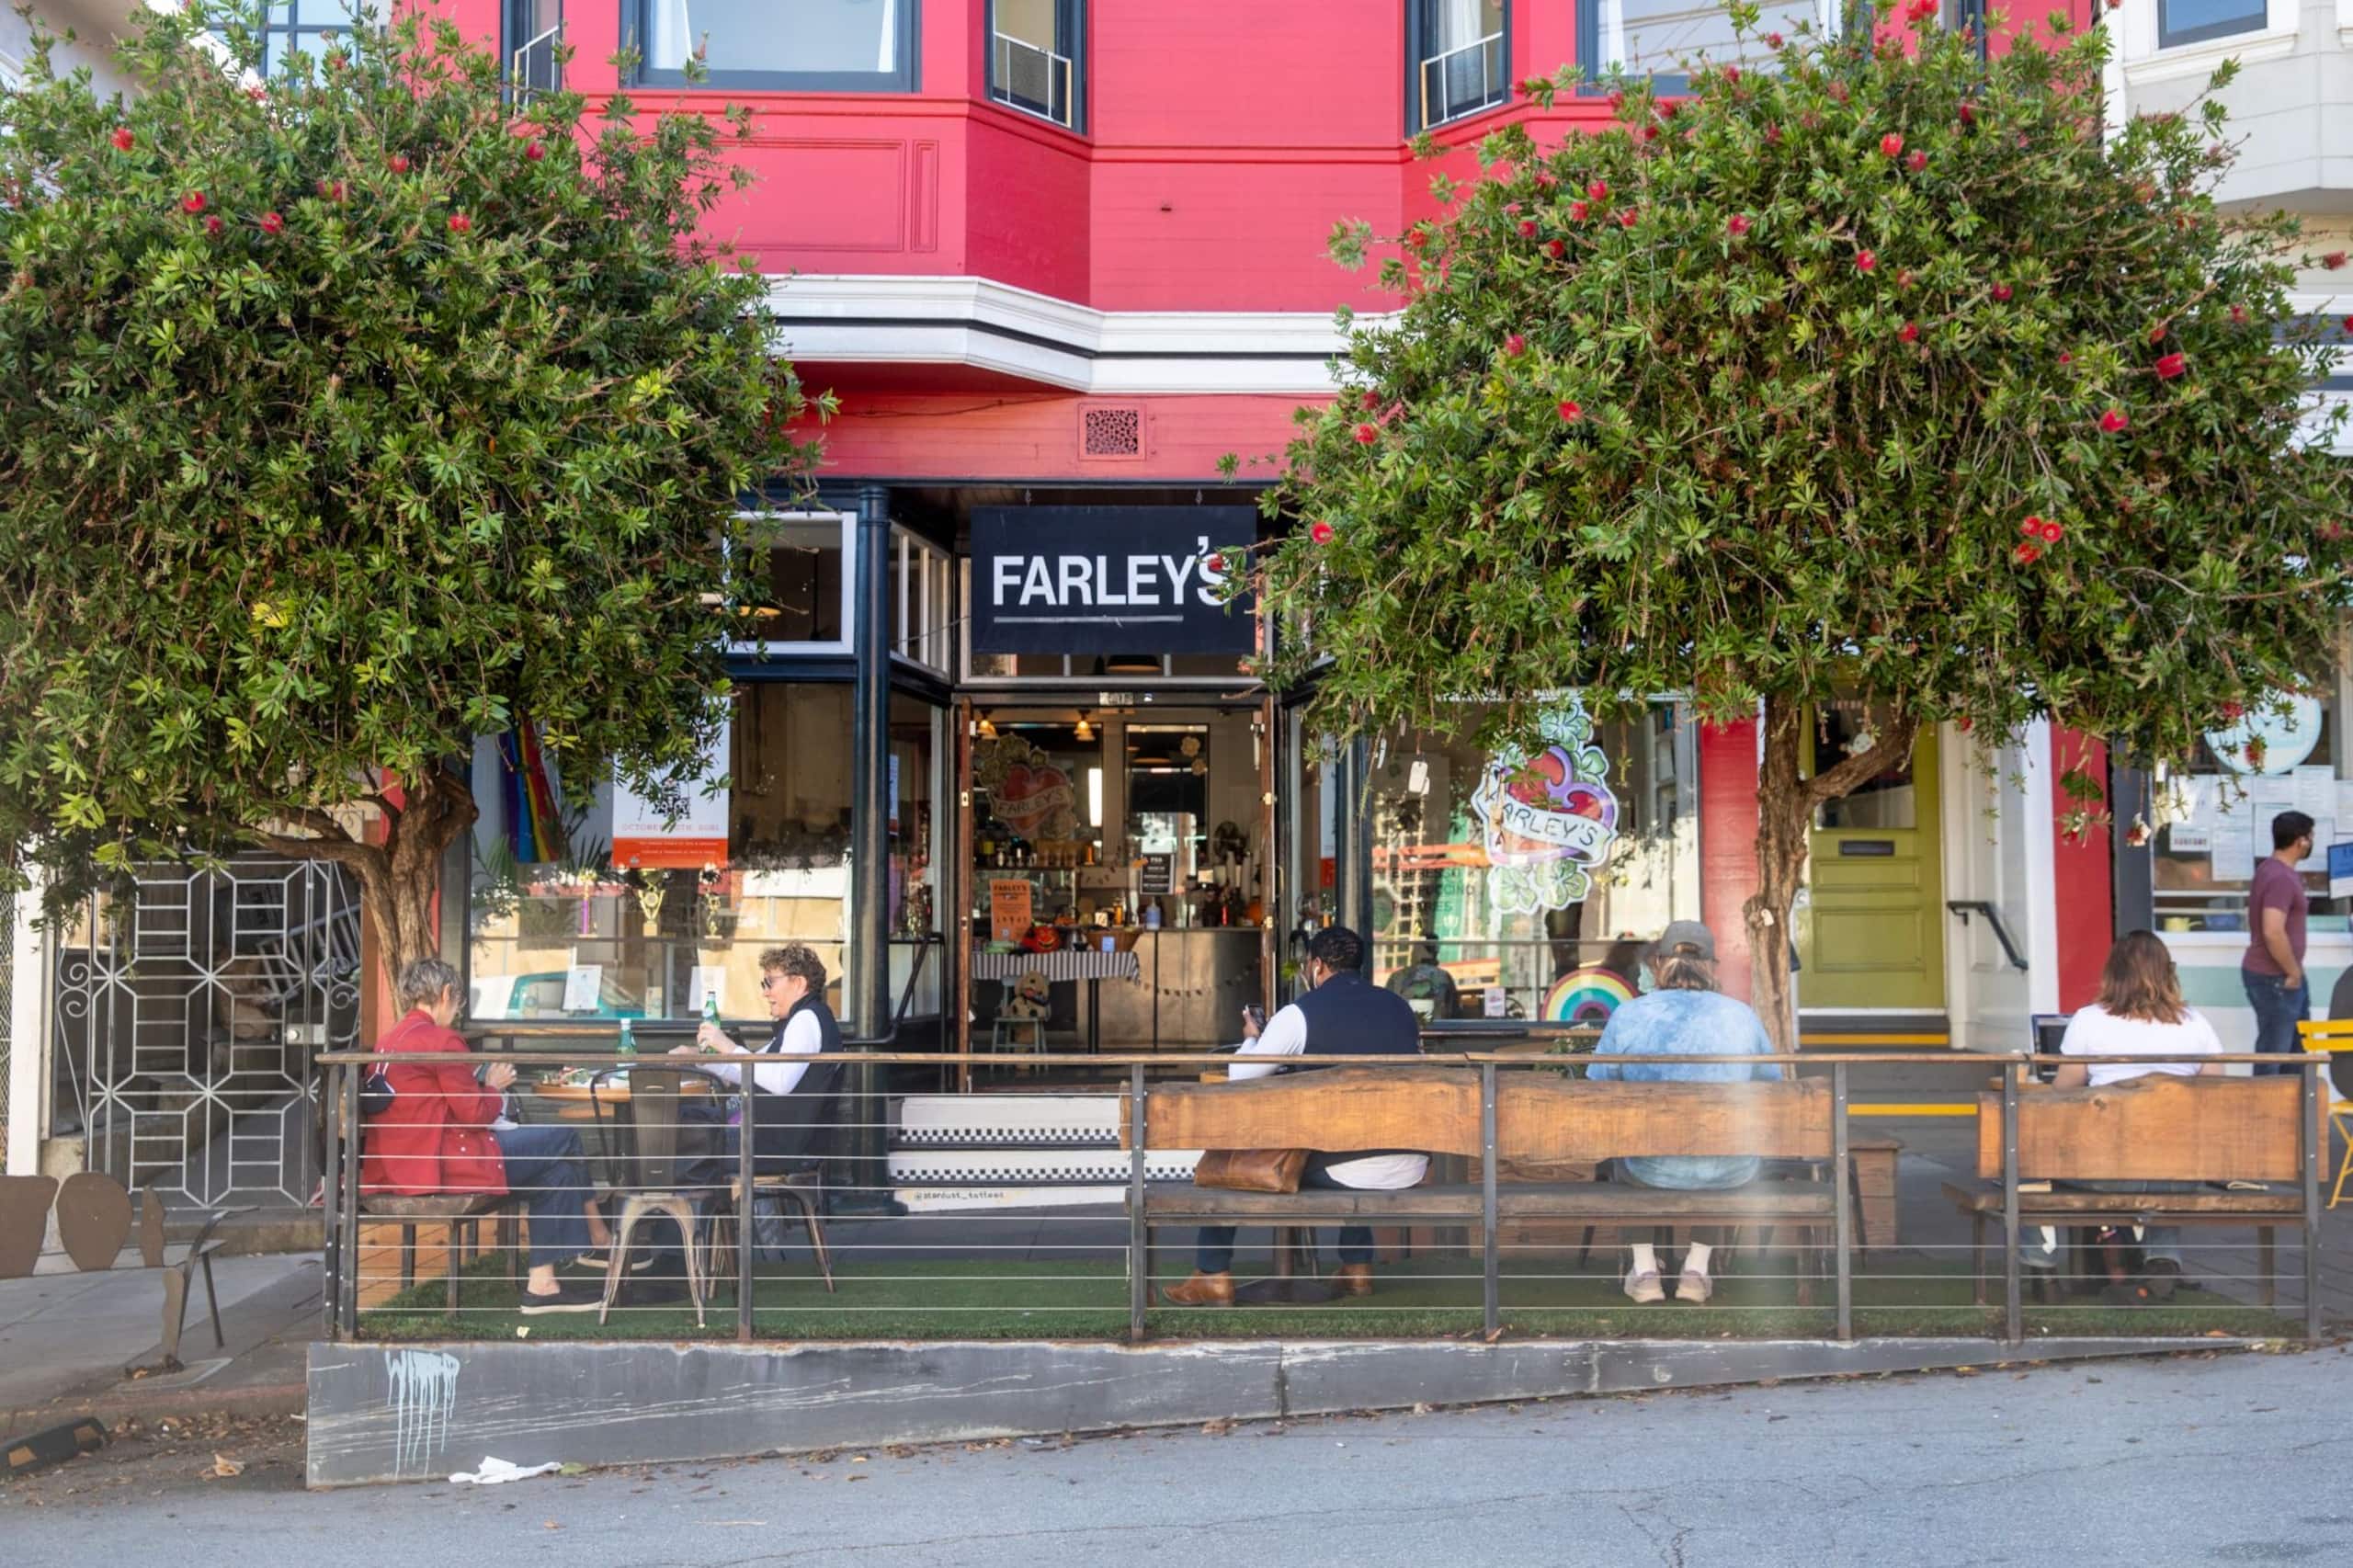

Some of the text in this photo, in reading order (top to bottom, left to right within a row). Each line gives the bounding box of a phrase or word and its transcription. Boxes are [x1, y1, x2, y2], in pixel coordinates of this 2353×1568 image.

[994, 536, 1232, 607] FARLEY'S
[998, 789, 1064, 813] FARLEY'S
[1489, 790, 1597, 846] ARLEY'S
